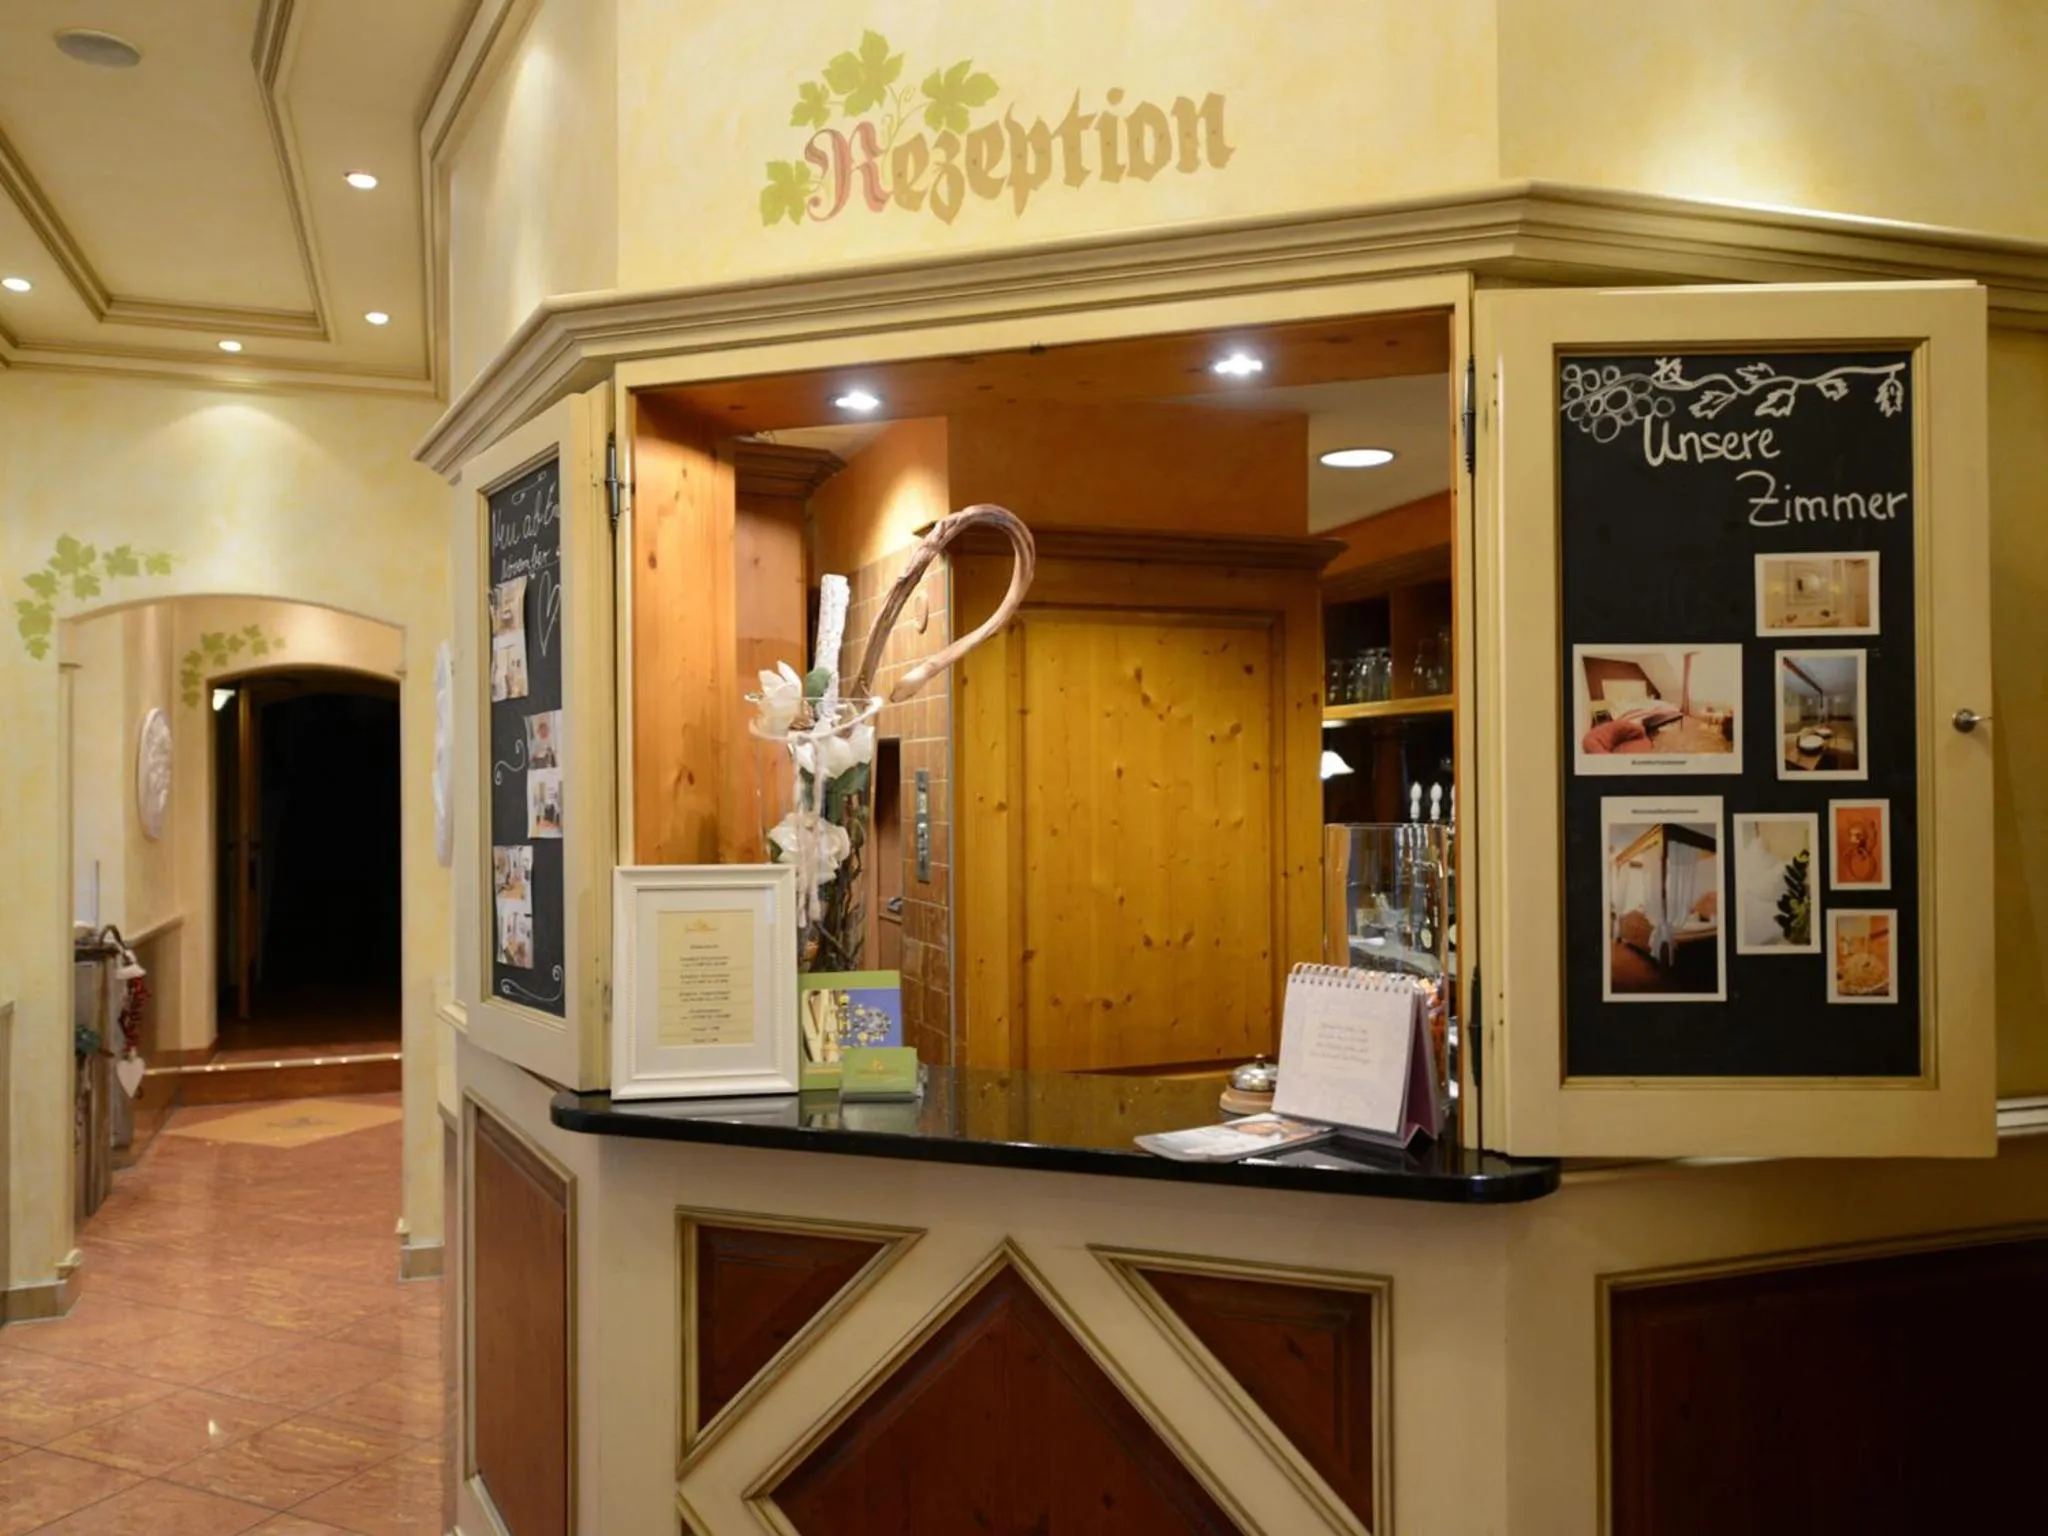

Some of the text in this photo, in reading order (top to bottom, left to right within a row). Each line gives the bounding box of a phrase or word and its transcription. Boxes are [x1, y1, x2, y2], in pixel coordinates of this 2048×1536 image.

[804, 86, 1236, 225] Rezeption
[1643, 415, 1782, 466] Unsere
[1735, 470, 1908, 527] Zimmer
